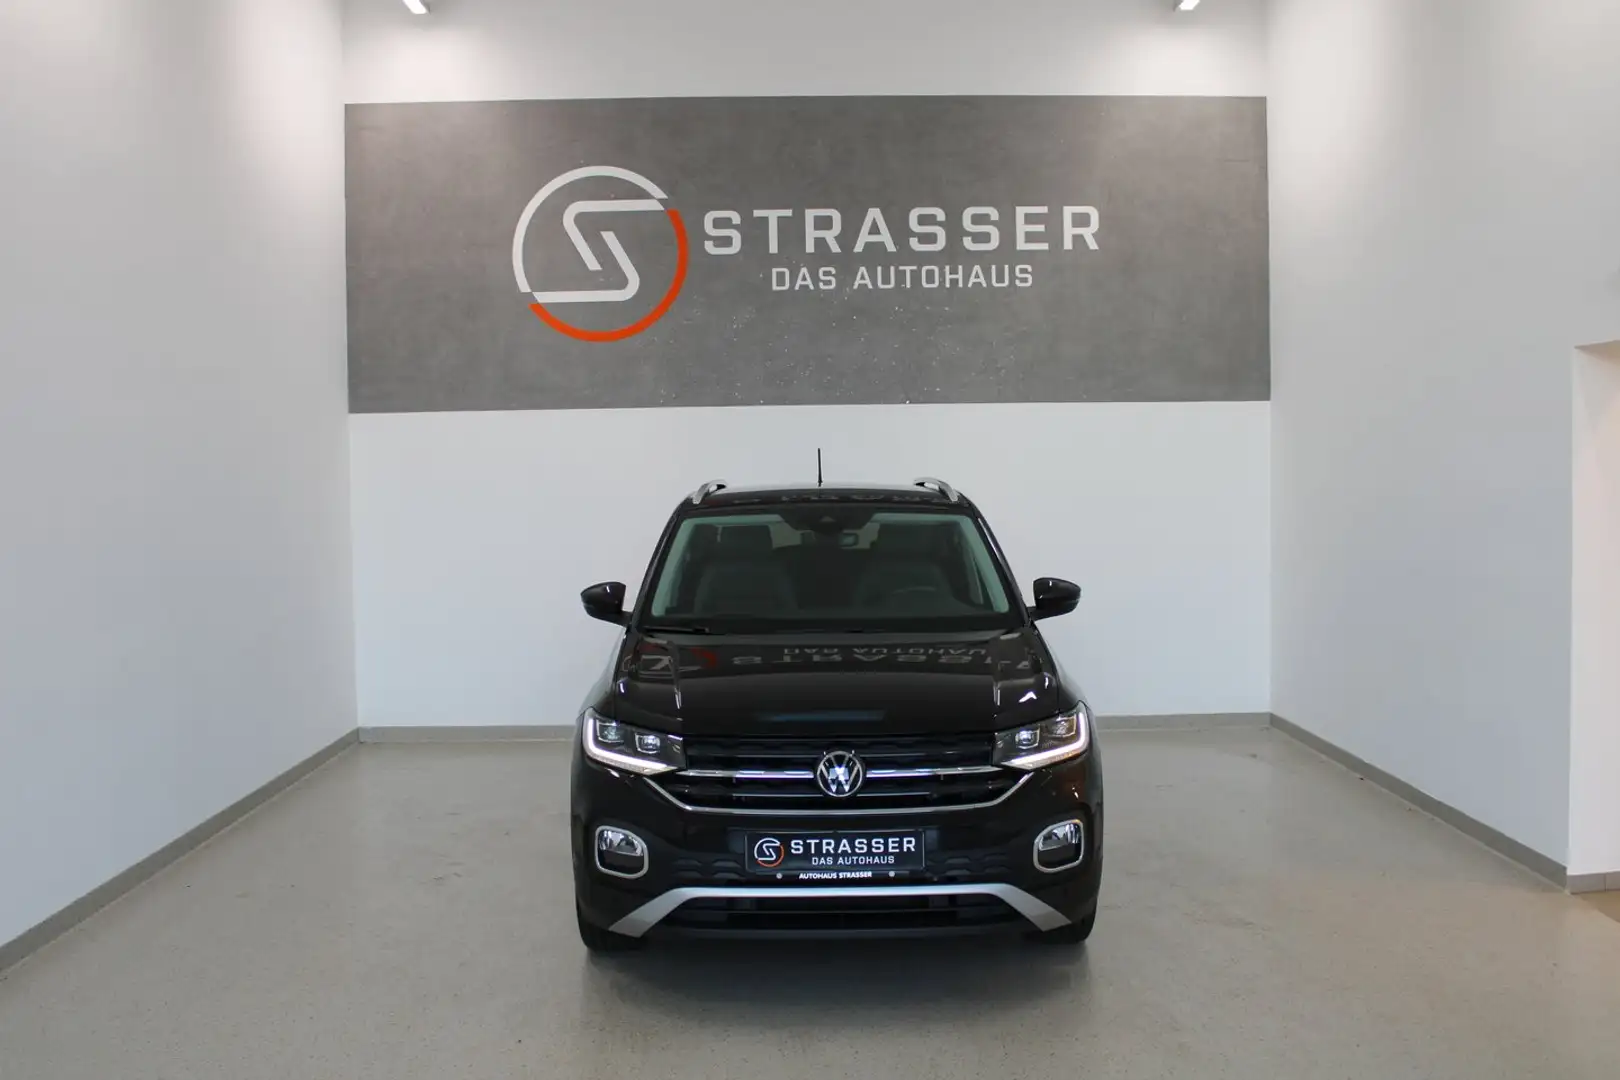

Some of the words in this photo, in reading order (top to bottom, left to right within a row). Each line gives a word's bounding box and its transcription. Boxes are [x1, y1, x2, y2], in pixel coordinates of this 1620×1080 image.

[703, 205, 1100, 255] STRASSER
[771, 266, 837, 291] DAS
[853, 264, 1034, 290] AUTOHAUS
[790, 837, 916, 854] STRASSER
[811, 856, 833, 866] DAS
[837, 855, 895, 866] AUTOHAUS
[798, 871, 838, 879] AUTOHAUS
[839, 871, 872, 879] STRASSER
